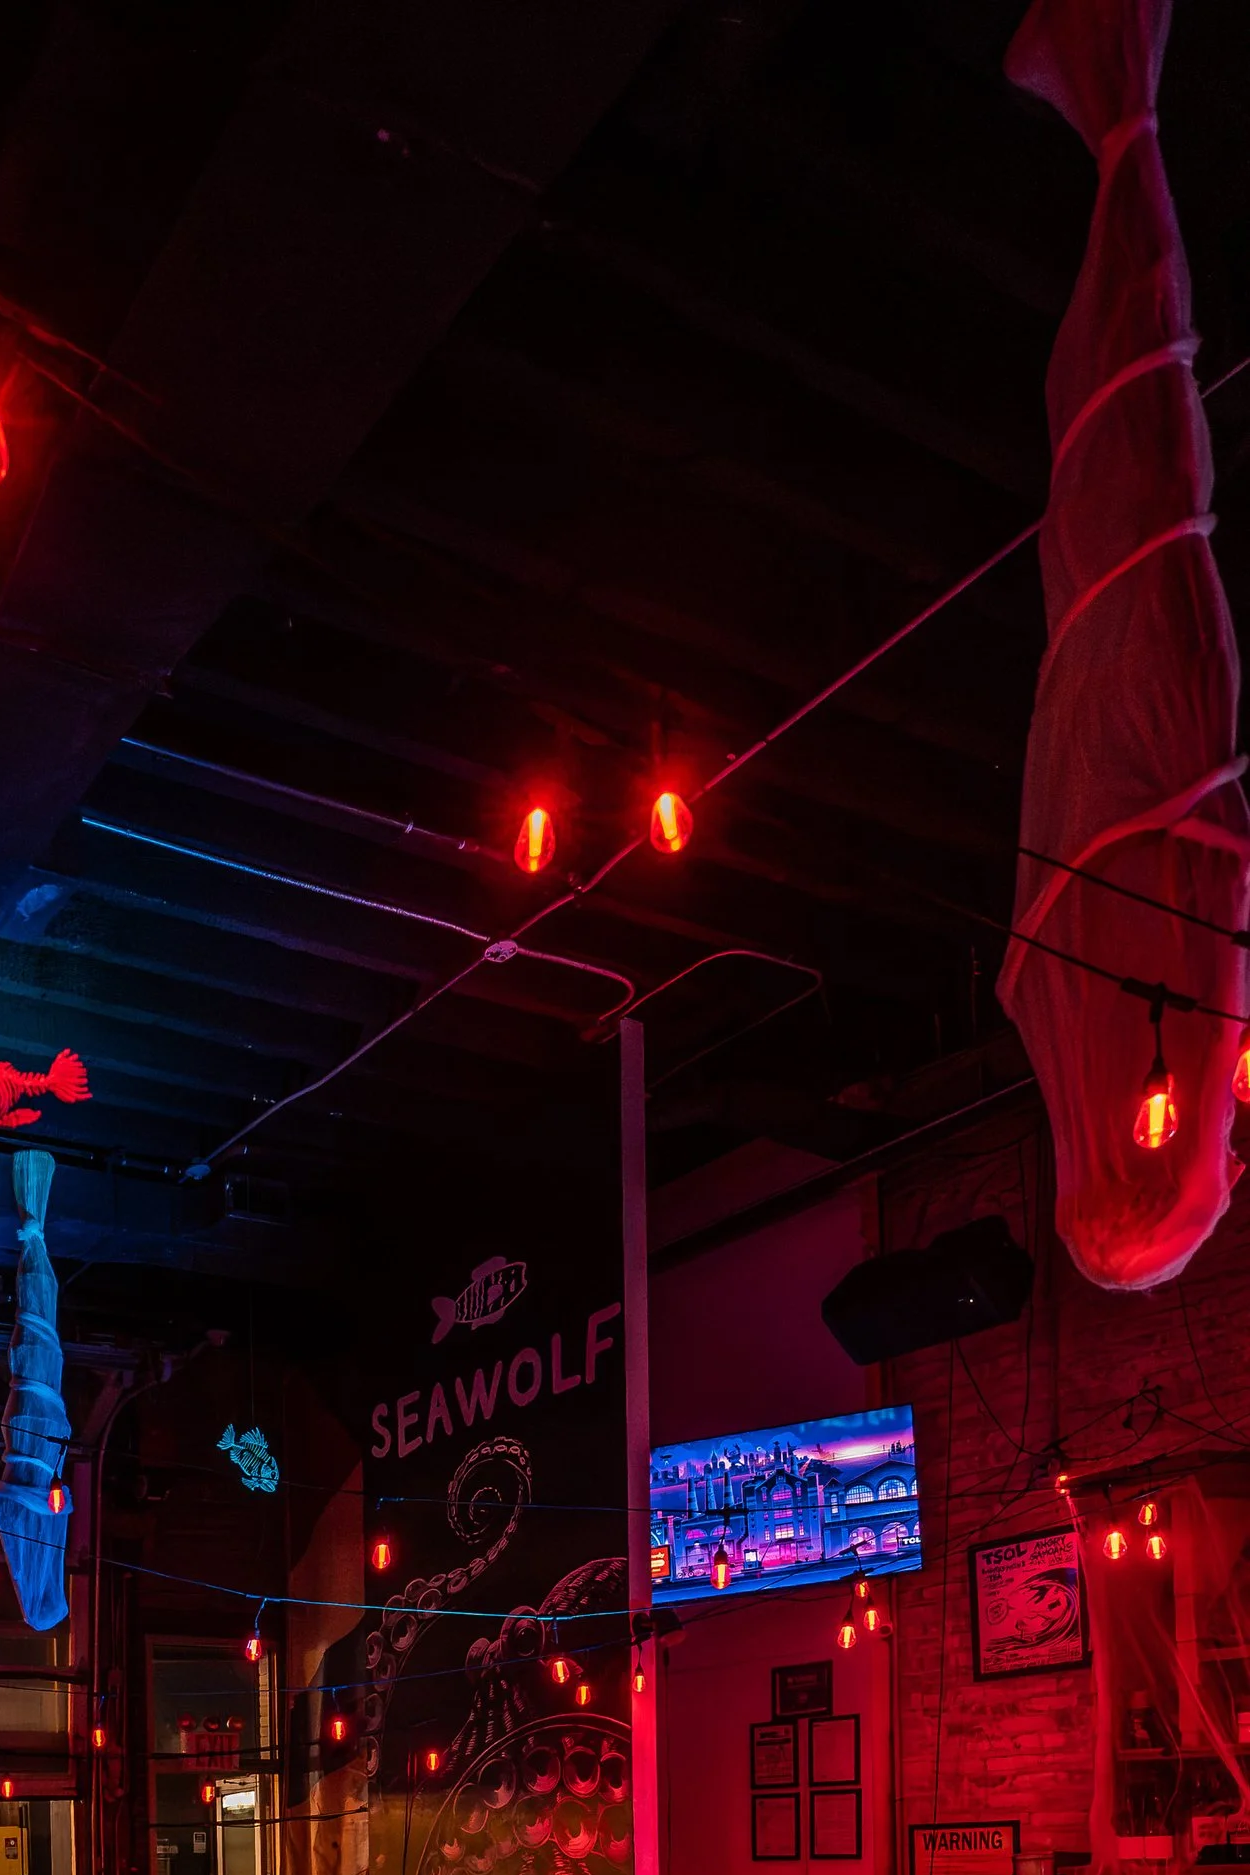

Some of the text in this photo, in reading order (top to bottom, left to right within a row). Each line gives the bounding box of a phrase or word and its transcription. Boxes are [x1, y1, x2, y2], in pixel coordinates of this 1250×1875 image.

[371, 1302, 622, 1458] SEAWOLF
[902, 1536, 921, 1545] TCL
[982, 1544, 1027, 1565] TSOL
[922, 1830, 1003, 1851] WARNING
